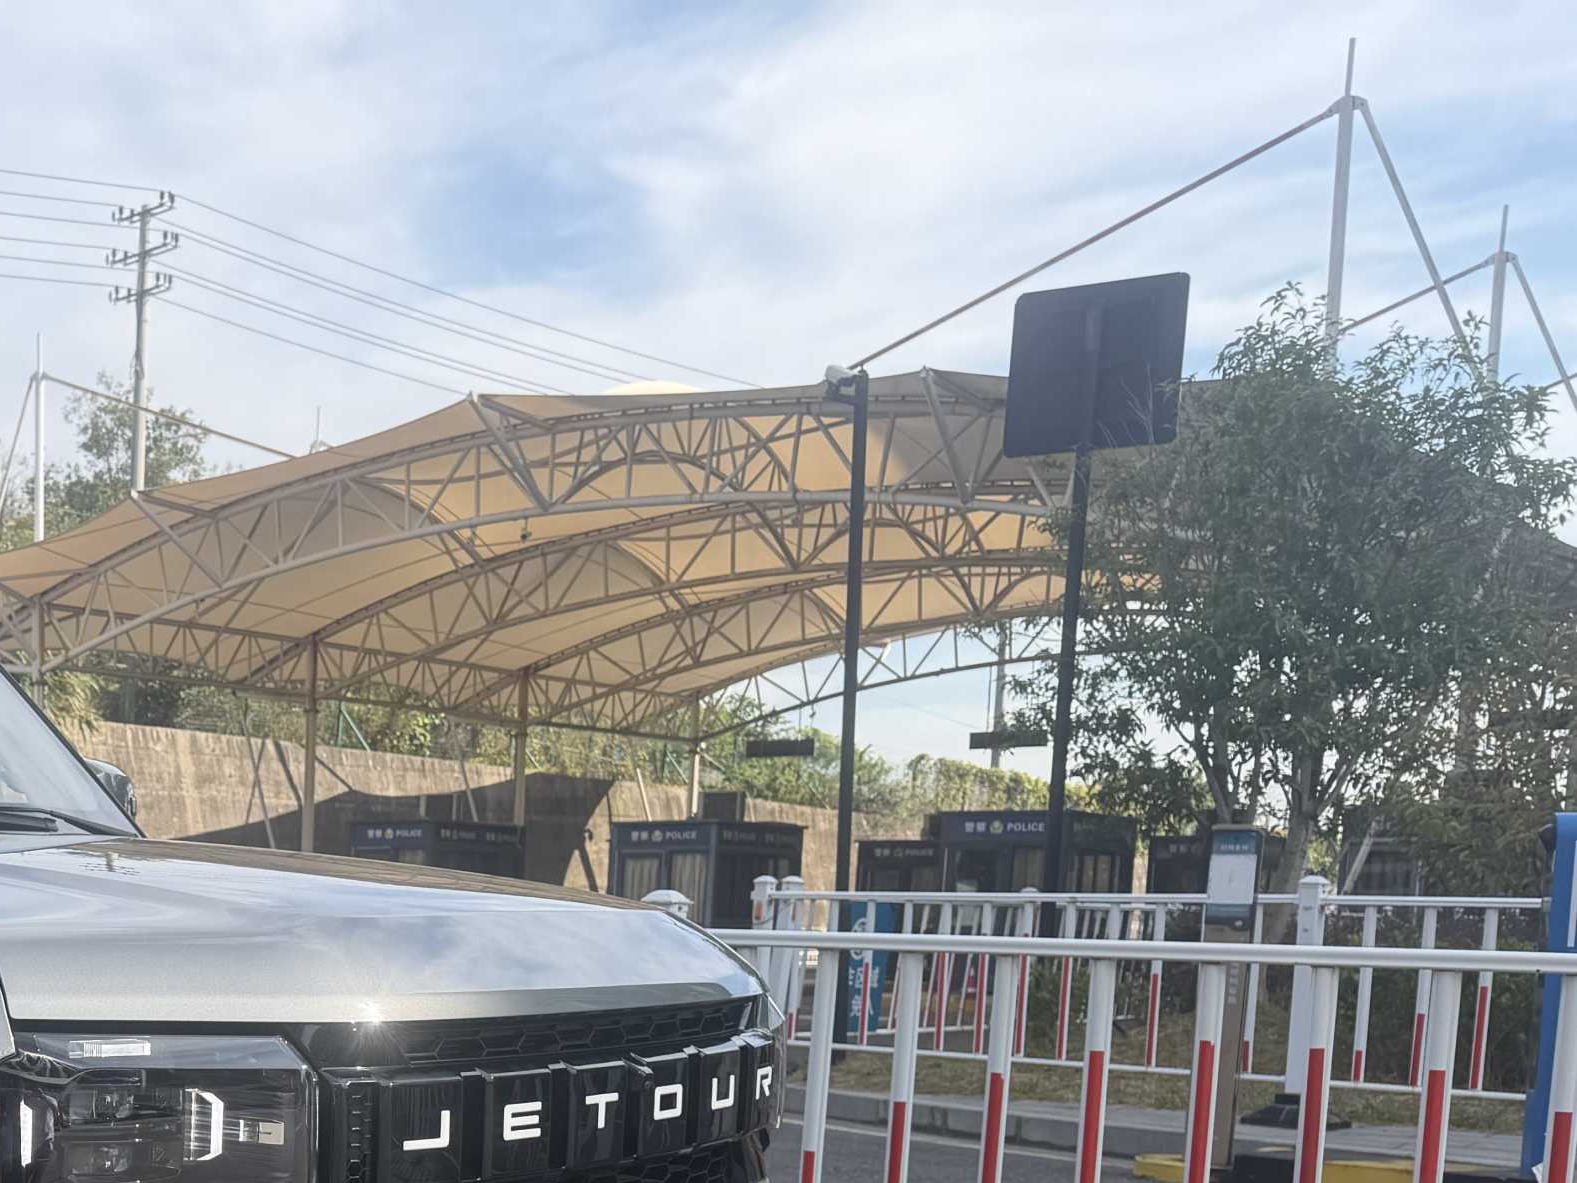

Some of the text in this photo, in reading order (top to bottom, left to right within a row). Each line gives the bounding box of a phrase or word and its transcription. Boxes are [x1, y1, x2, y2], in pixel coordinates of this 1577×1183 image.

[1006, 822, 1046, 832] POLICE
[395, 829, 423, 838] POLICE
[665, 831, 697, 840] POLICE
[402, 1066, 773, 1151] JETOUR
